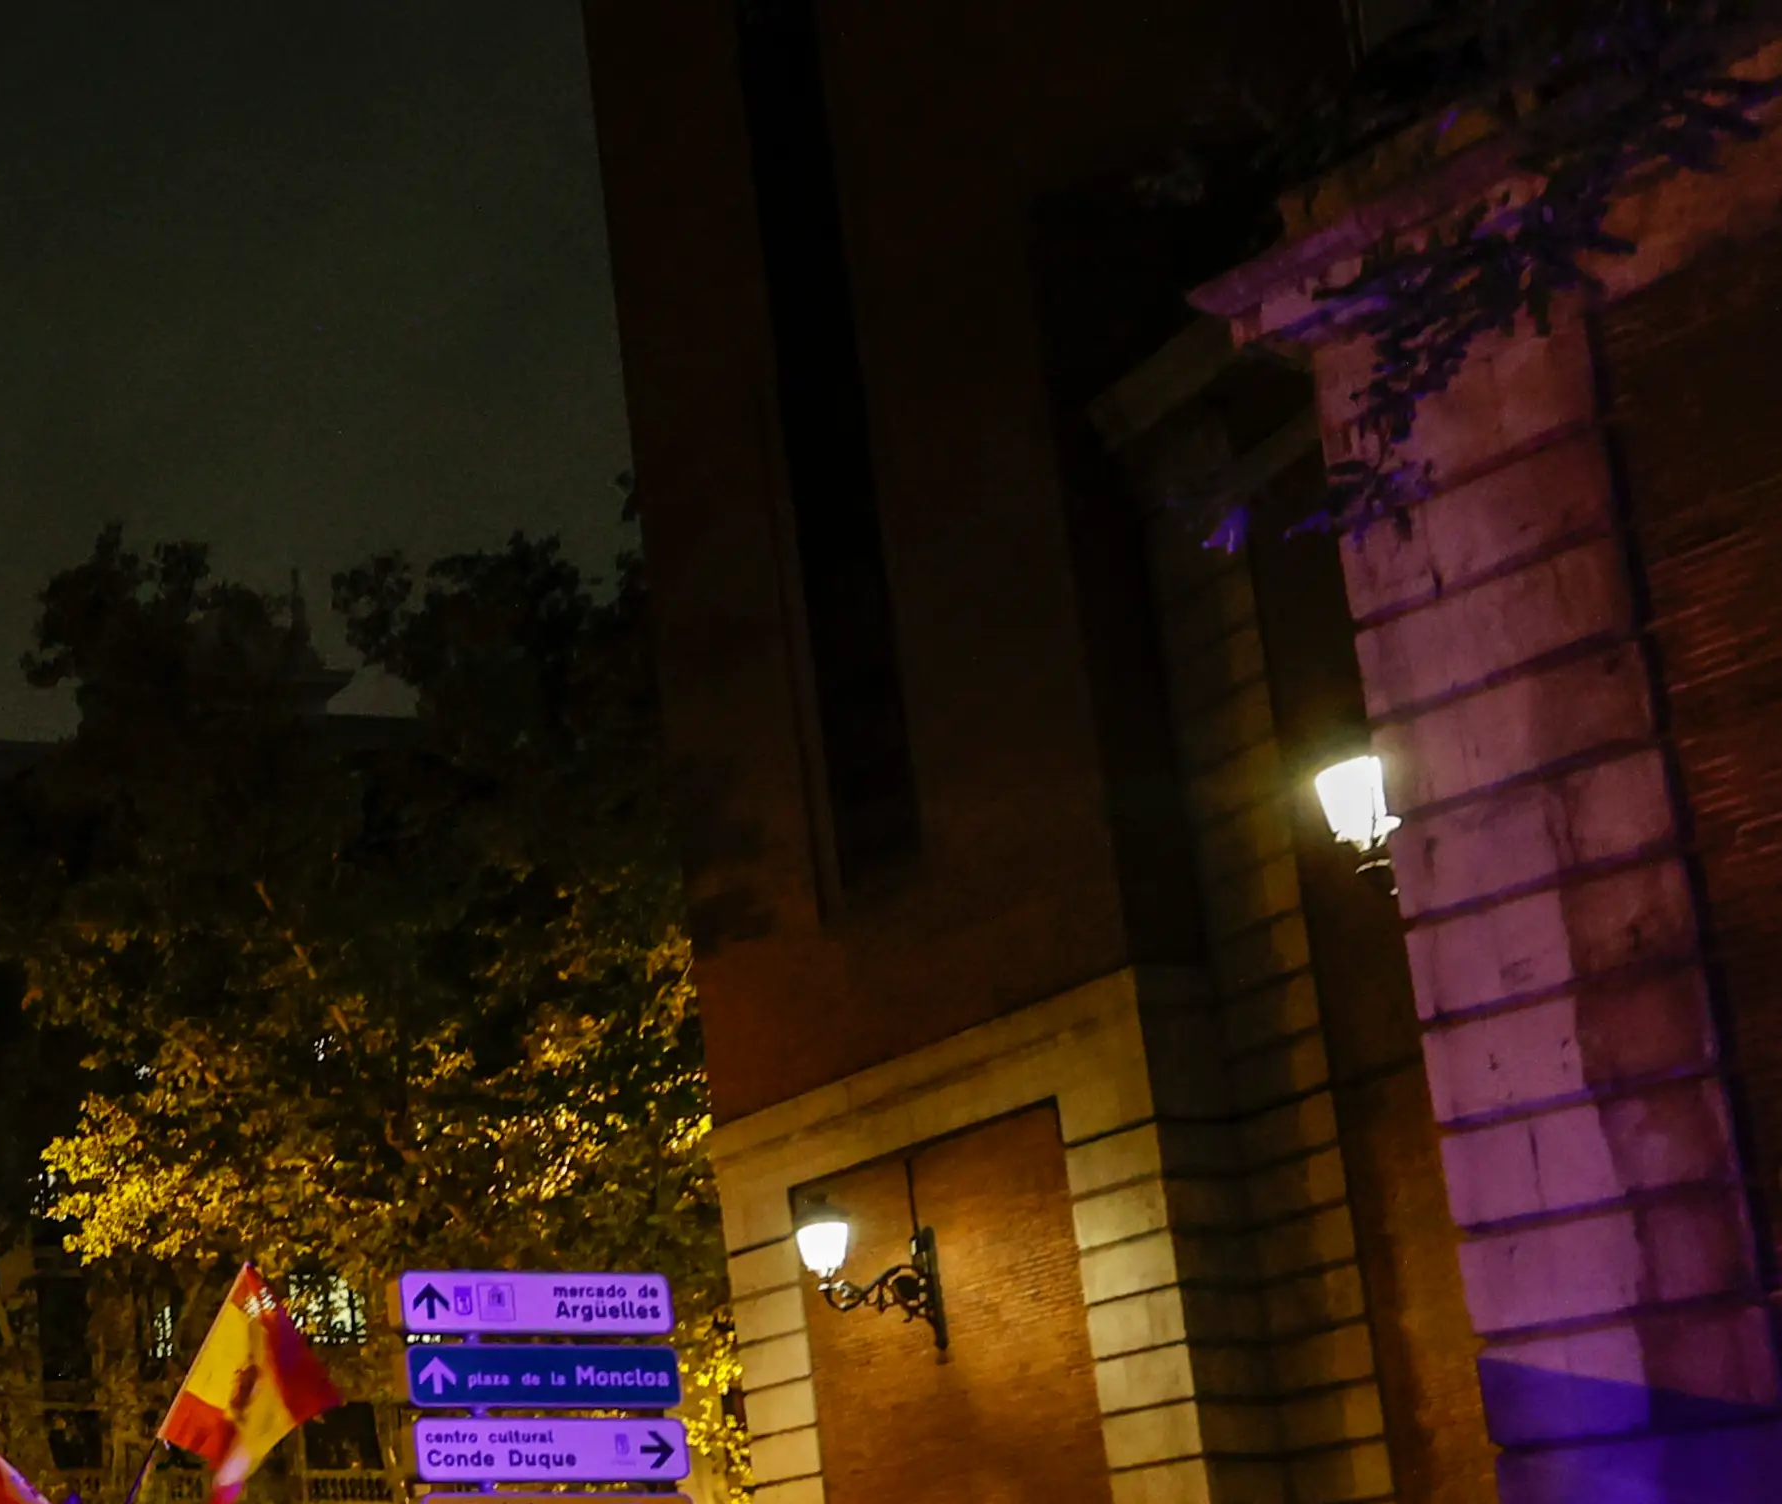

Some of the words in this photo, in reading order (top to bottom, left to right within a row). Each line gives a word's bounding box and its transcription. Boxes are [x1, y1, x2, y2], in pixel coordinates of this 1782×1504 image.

[553, 1284, 627, 1298] mercado
[637, 1284, 659, 1298] de
[555, 1301, 662, 1322] Argüelles
[467, 1371, 510, 1387] plaza
[521, 1371, 541, 1386] de
[550, 1371, 566, 1386] la
[575, 1365, 670, 1387] Moncloa
[425, 1432, 478, 1444] centro
[488, 1430, 554, 1444] cultural
[426, 1450, 495, 1467] Conde
[508, 1450, 577, 1470] Duque
